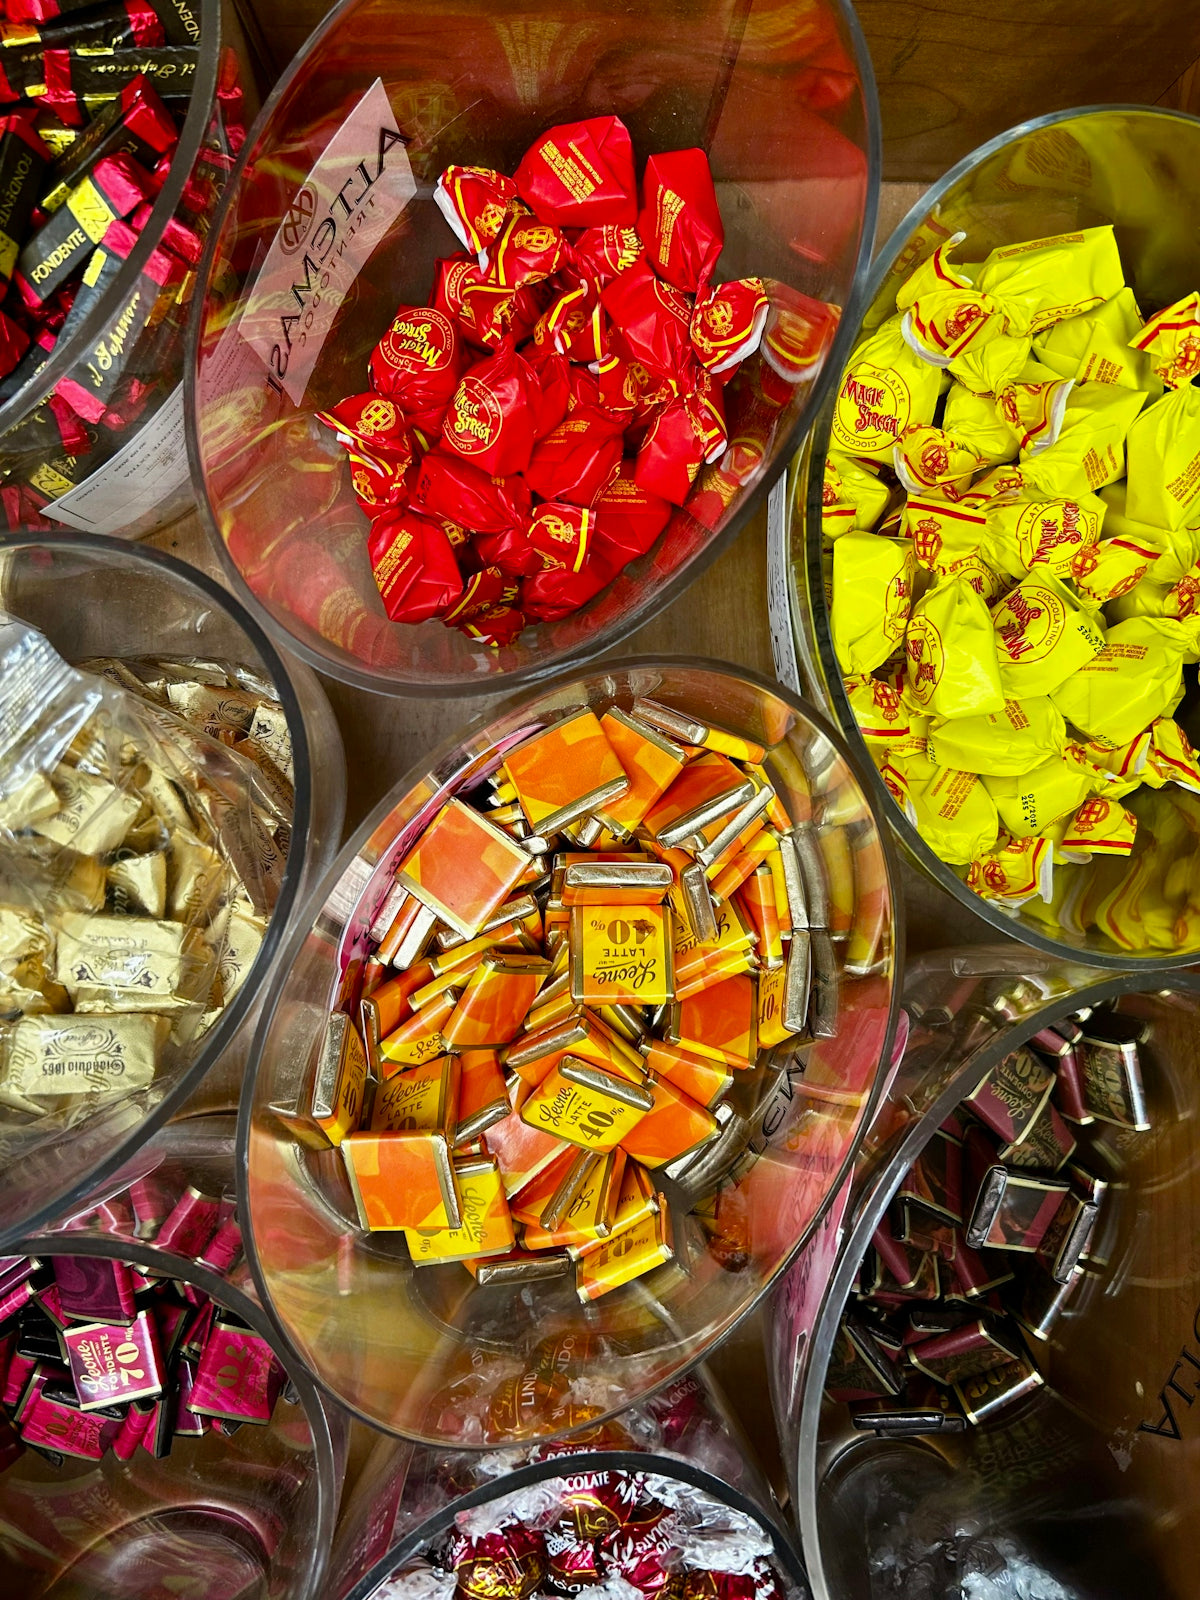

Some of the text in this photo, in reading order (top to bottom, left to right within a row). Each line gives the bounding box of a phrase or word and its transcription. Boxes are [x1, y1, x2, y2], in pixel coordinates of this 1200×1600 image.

[30, 228, 87, 285] FONDENTE
[393, 318, 443, 368] MAGIE STREGA
[412, 309, 453, 351] CIOCCOLATINO
[839, 373, 903, 438] MAGIE STREGA
[884, 370, 907, 405] LATTE
[453, 381, 494, 445] MAGIE STREGA
[1035, 589, 1062, 647] CIOCCOLATINO
[1027, 792, 1038, 828] 07/2025
[590, 918, 658, 945] 40%
[602, 947, 646, 958] LATTE
[597, 958, 657, 991] Leone
[41, 1060, 66, 1076] 1865
[374, 1074, 435, 1116] Leone
[387, 1101, 424, 1120] LATTE
[538, 1085, 574, 1128] Leone
[565, 1100, 593, 1127] LATTE
[988, 1079, 1029, 1123] Leone
[575, 1104, 627, 1144] 40%
[463, 1186, 483, 1245] Leone
[79, 1338, 104, 1395] Leone
[100, 1333, 120, 1392] FONDENTE
[116, 1325, 146, 1387] 70%
